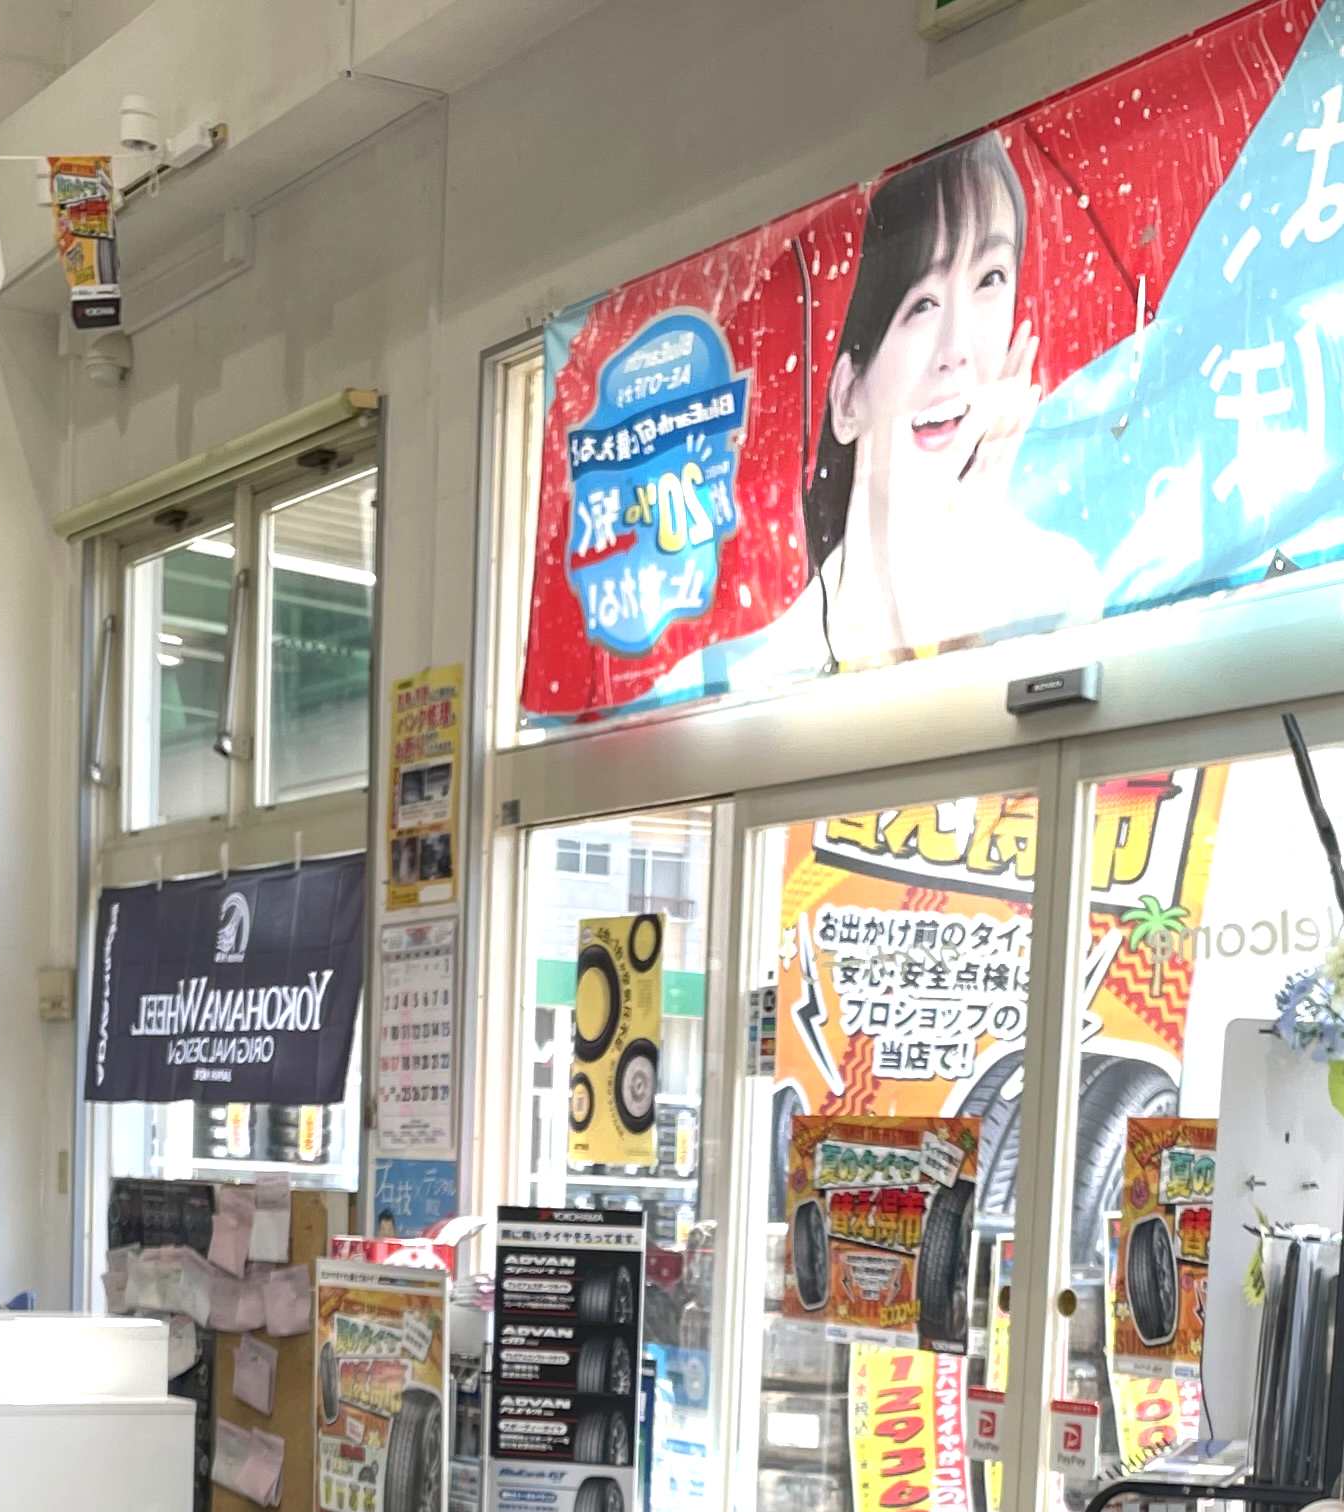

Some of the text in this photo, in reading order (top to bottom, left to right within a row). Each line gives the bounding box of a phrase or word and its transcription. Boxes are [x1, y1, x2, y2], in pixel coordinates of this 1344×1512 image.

[819, 908, 1036, 950] お出かけ前のタイ
[878, 1040, 971, 1072] 当店で!
[504, 1254, 577, 1268] ADVAN
[501, 1324, 575, 1340] ADVAN
[499, 1395, 572, 1410] ADVAN
[1056, 1452, 1087, 1467] PayPay
